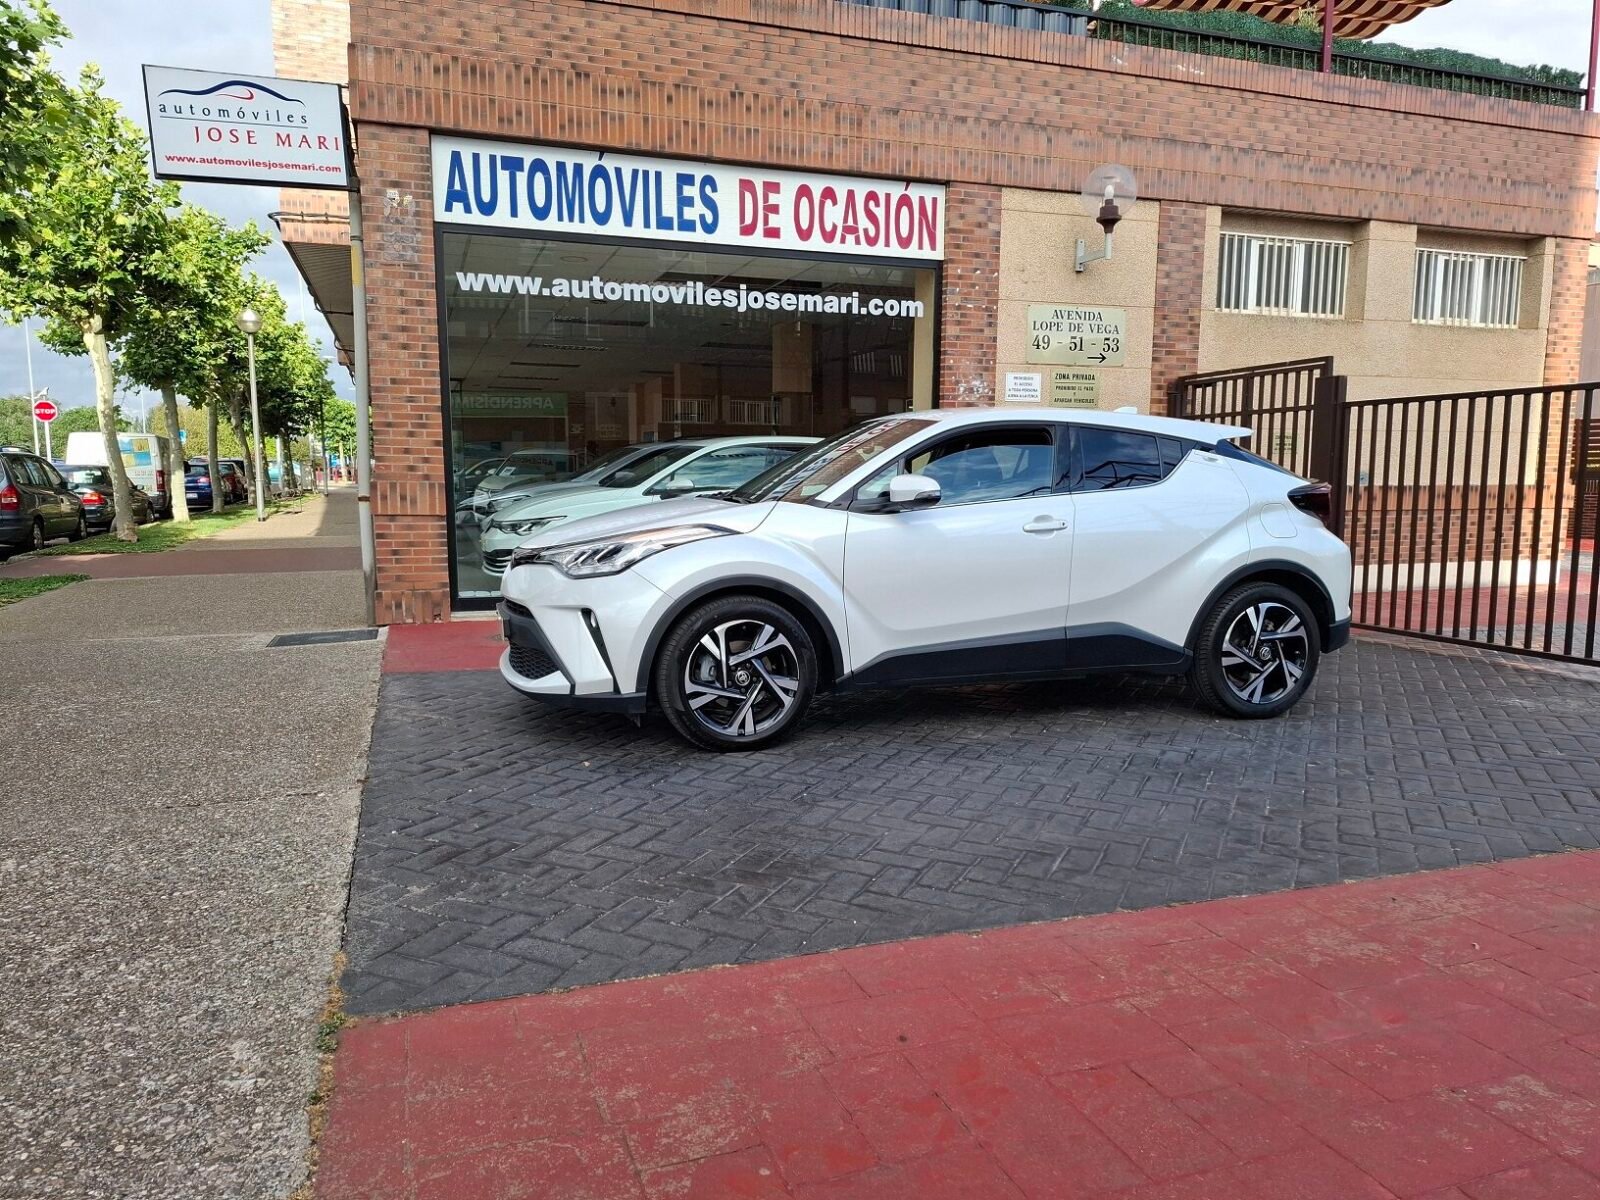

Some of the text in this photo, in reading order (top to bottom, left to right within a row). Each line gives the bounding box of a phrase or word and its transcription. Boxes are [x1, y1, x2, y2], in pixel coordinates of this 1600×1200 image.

[158, 103, 307, 124] automóviles
[194, 126, 340, 151] JOSE MARI
[165, 154, 342, 173] www.automovilesjosemari.com
[444, 150, 938, 251] AUTOMÓVILES DE OCASIÓN
[456, 272, 924, 318] www.automovilesjosemari.com
[1052, 309, 1103, 322] AVENIDA
[1032, 320, 1120, 335] LOPE DE VEGA
[1032, 334, 1051, 350] 49
[1069, 336, 1085, 351] 51
[1102, 337, 1120, 353] 53
[1054, 373, 1096, 381] ZONA PRIVADA
